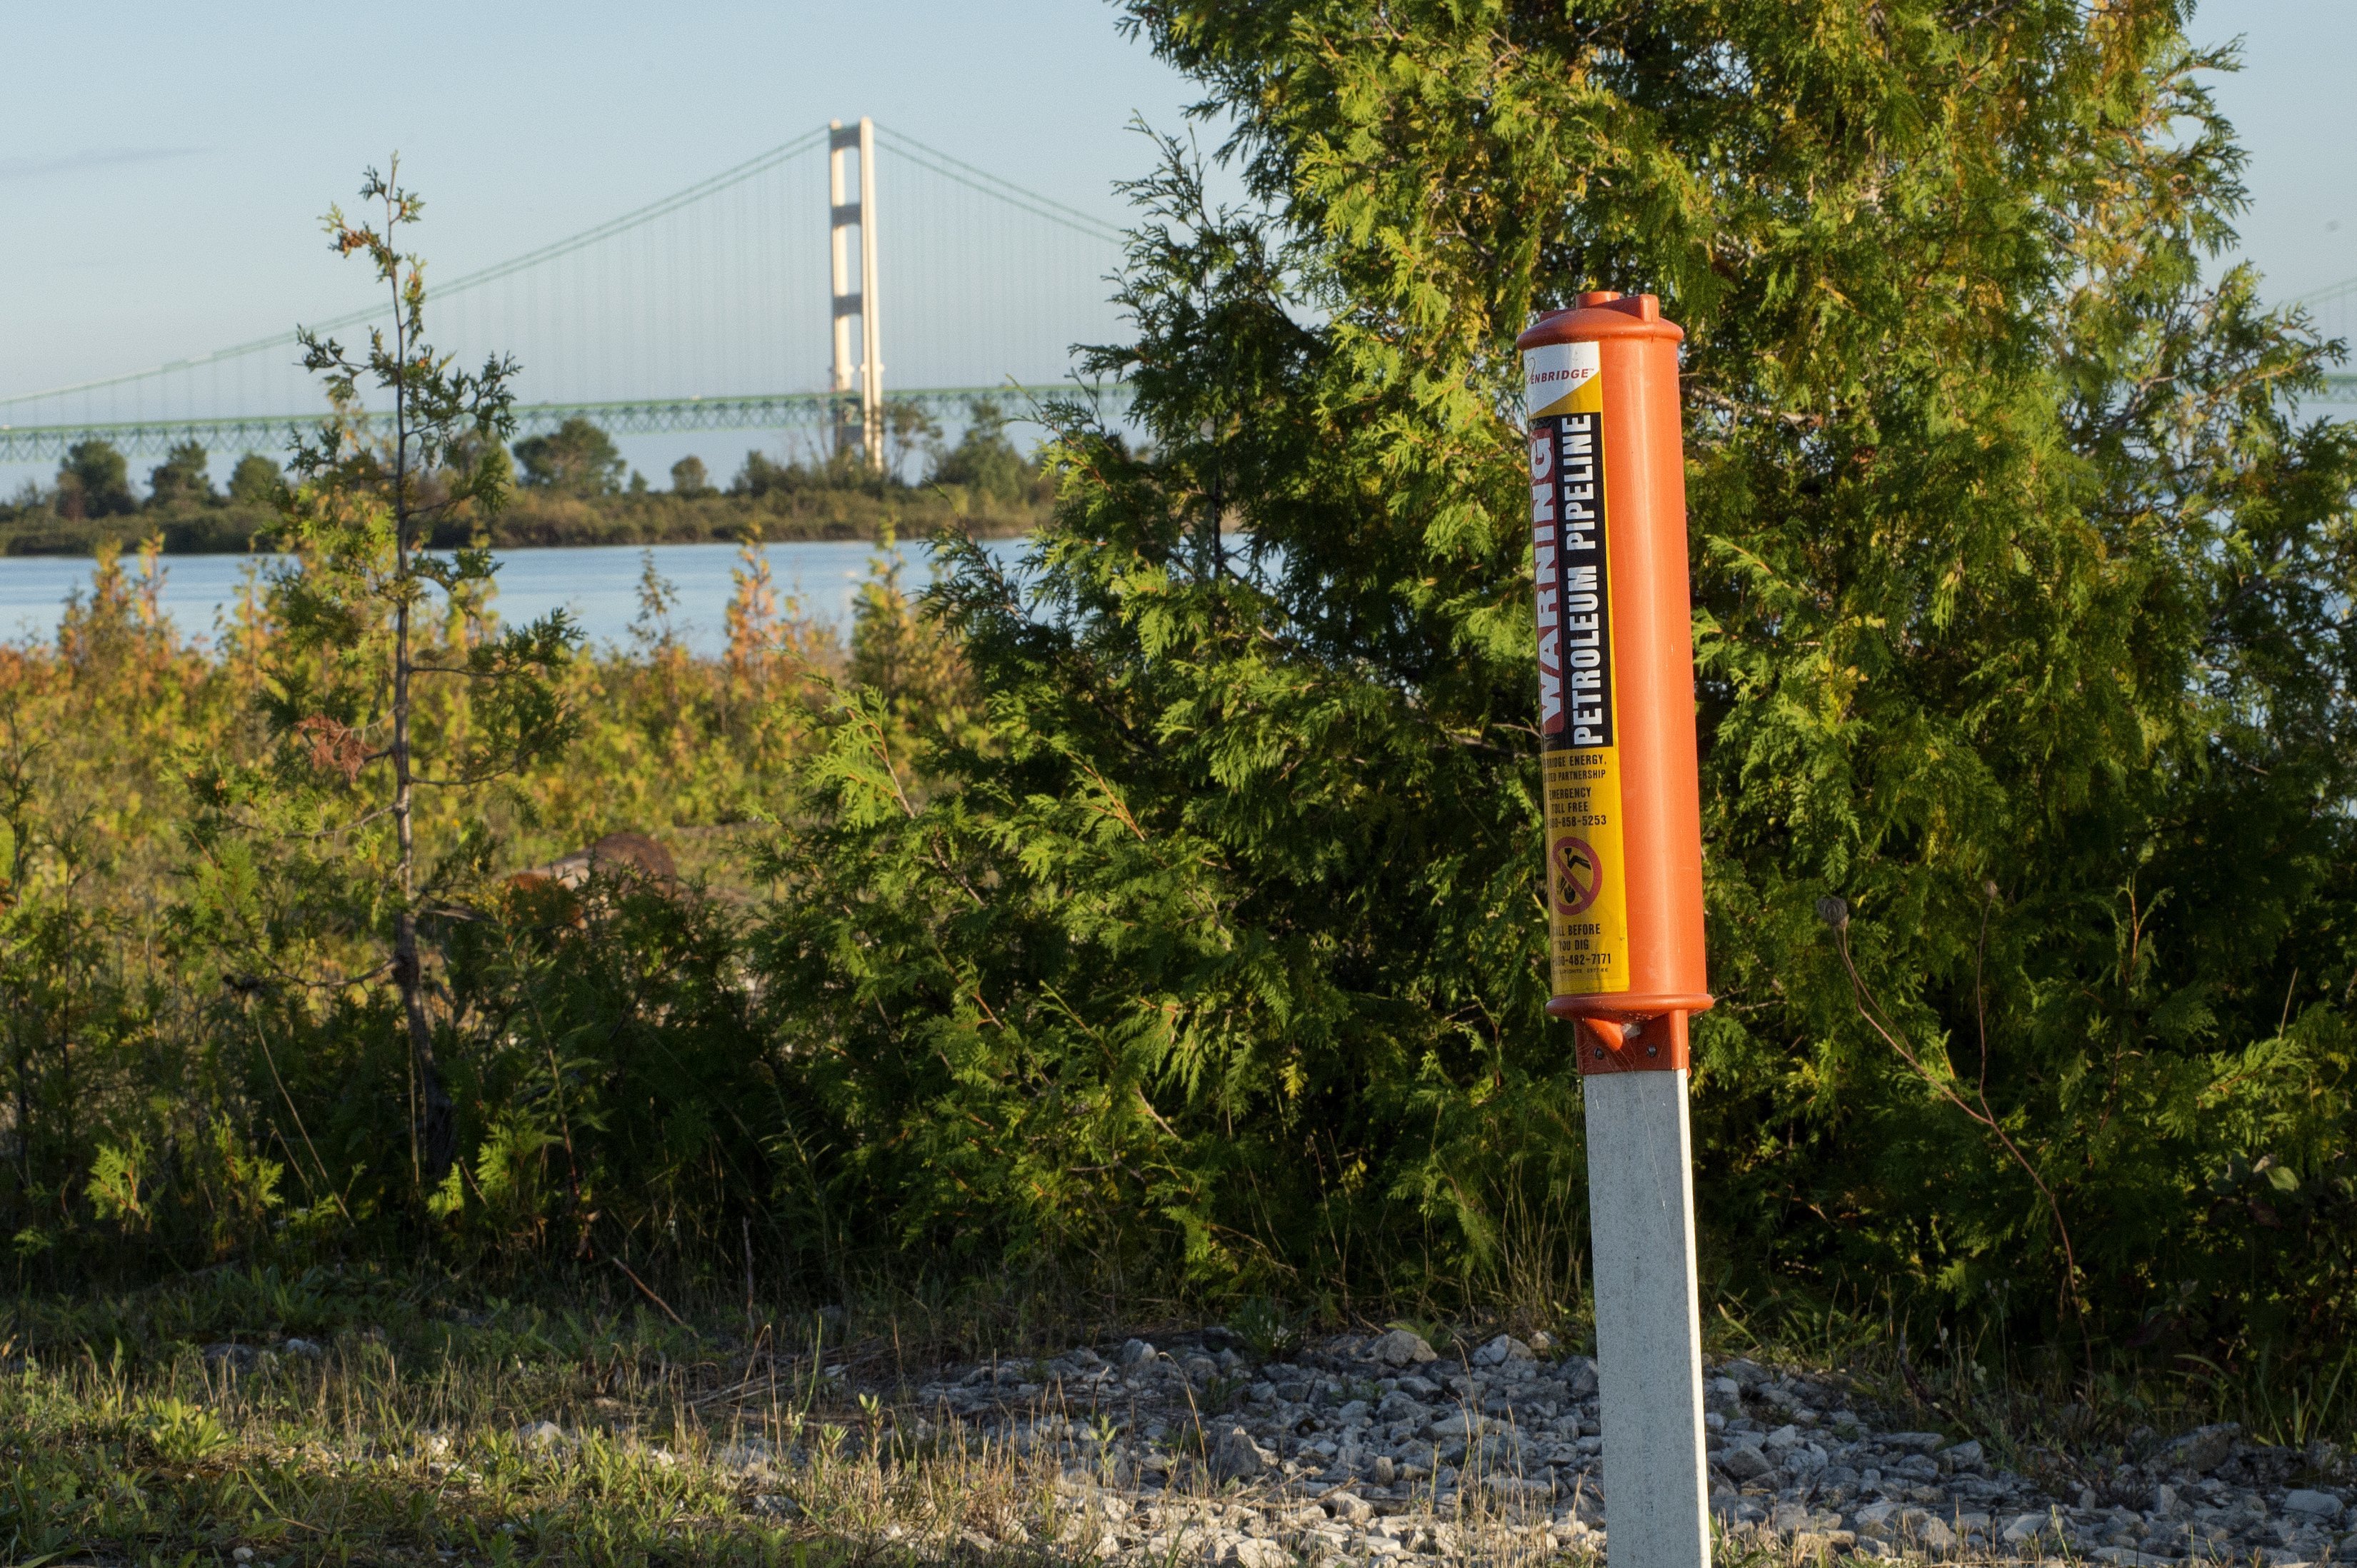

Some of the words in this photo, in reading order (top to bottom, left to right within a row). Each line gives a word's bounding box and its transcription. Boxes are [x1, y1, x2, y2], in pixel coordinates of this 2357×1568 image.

[1561, 414, 1596, 551] PIPELINE
[1530, 436, 1561, 725] WARNING
[1567, 565, 1603, 745] PETROLEUM
[1569, 754, 1607, 765] ENERGY,
[1558, 770, 1606, 780] PARTNERSHIP
[1548, 787, 1591, 800] EMERGENCY
[1551, 803, 1565, 813] TOLL
[1568, 801, 1588, 813] FREE
[1568, 923, 1601, 935] BEFORE
[1558, 940, 1571, 952] YOU
[1574, 938, 1589, 951] DIG
